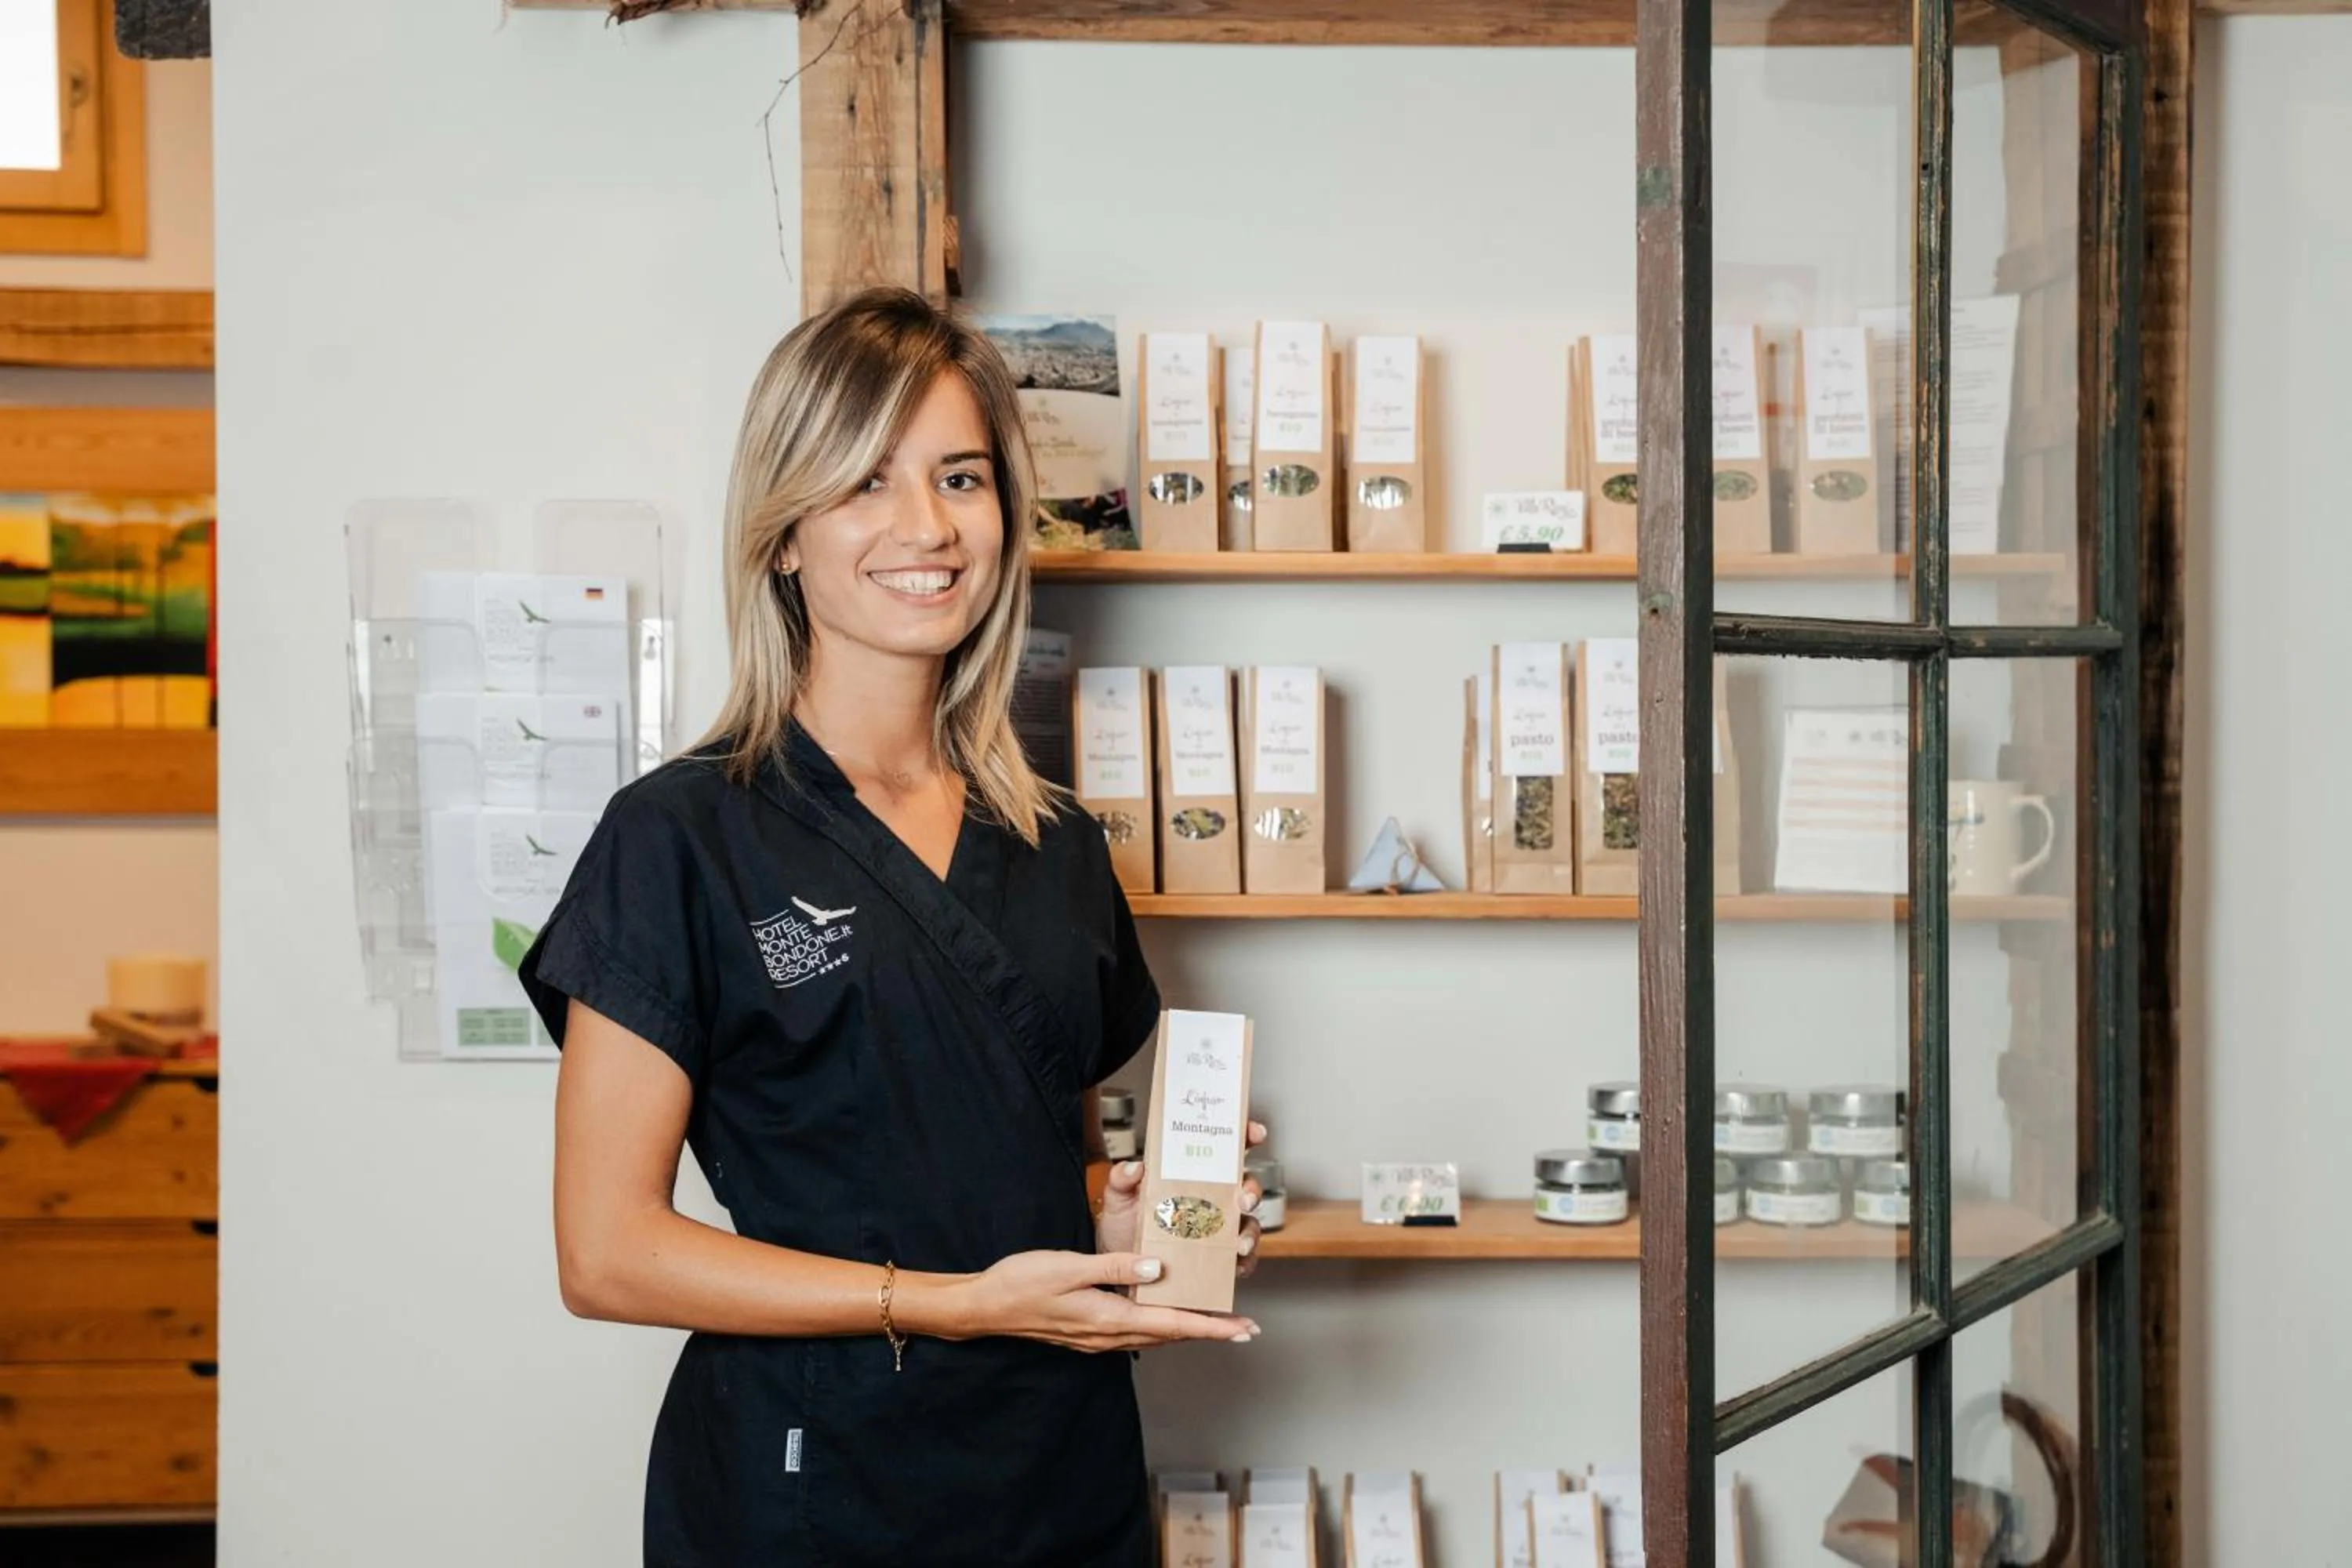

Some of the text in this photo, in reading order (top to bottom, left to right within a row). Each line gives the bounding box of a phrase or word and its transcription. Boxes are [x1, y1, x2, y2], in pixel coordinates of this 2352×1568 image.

[1510, 731, 1555, 747] pasto
[751, 916, 803, 941] HOTEL
[758, 923, 813, 955] MONTE
[768, 947, 828, 981] RESORT
[1171, 1119, 1234, 1136] Montagna
[1185, 1143, 1214, 1156] BIO
